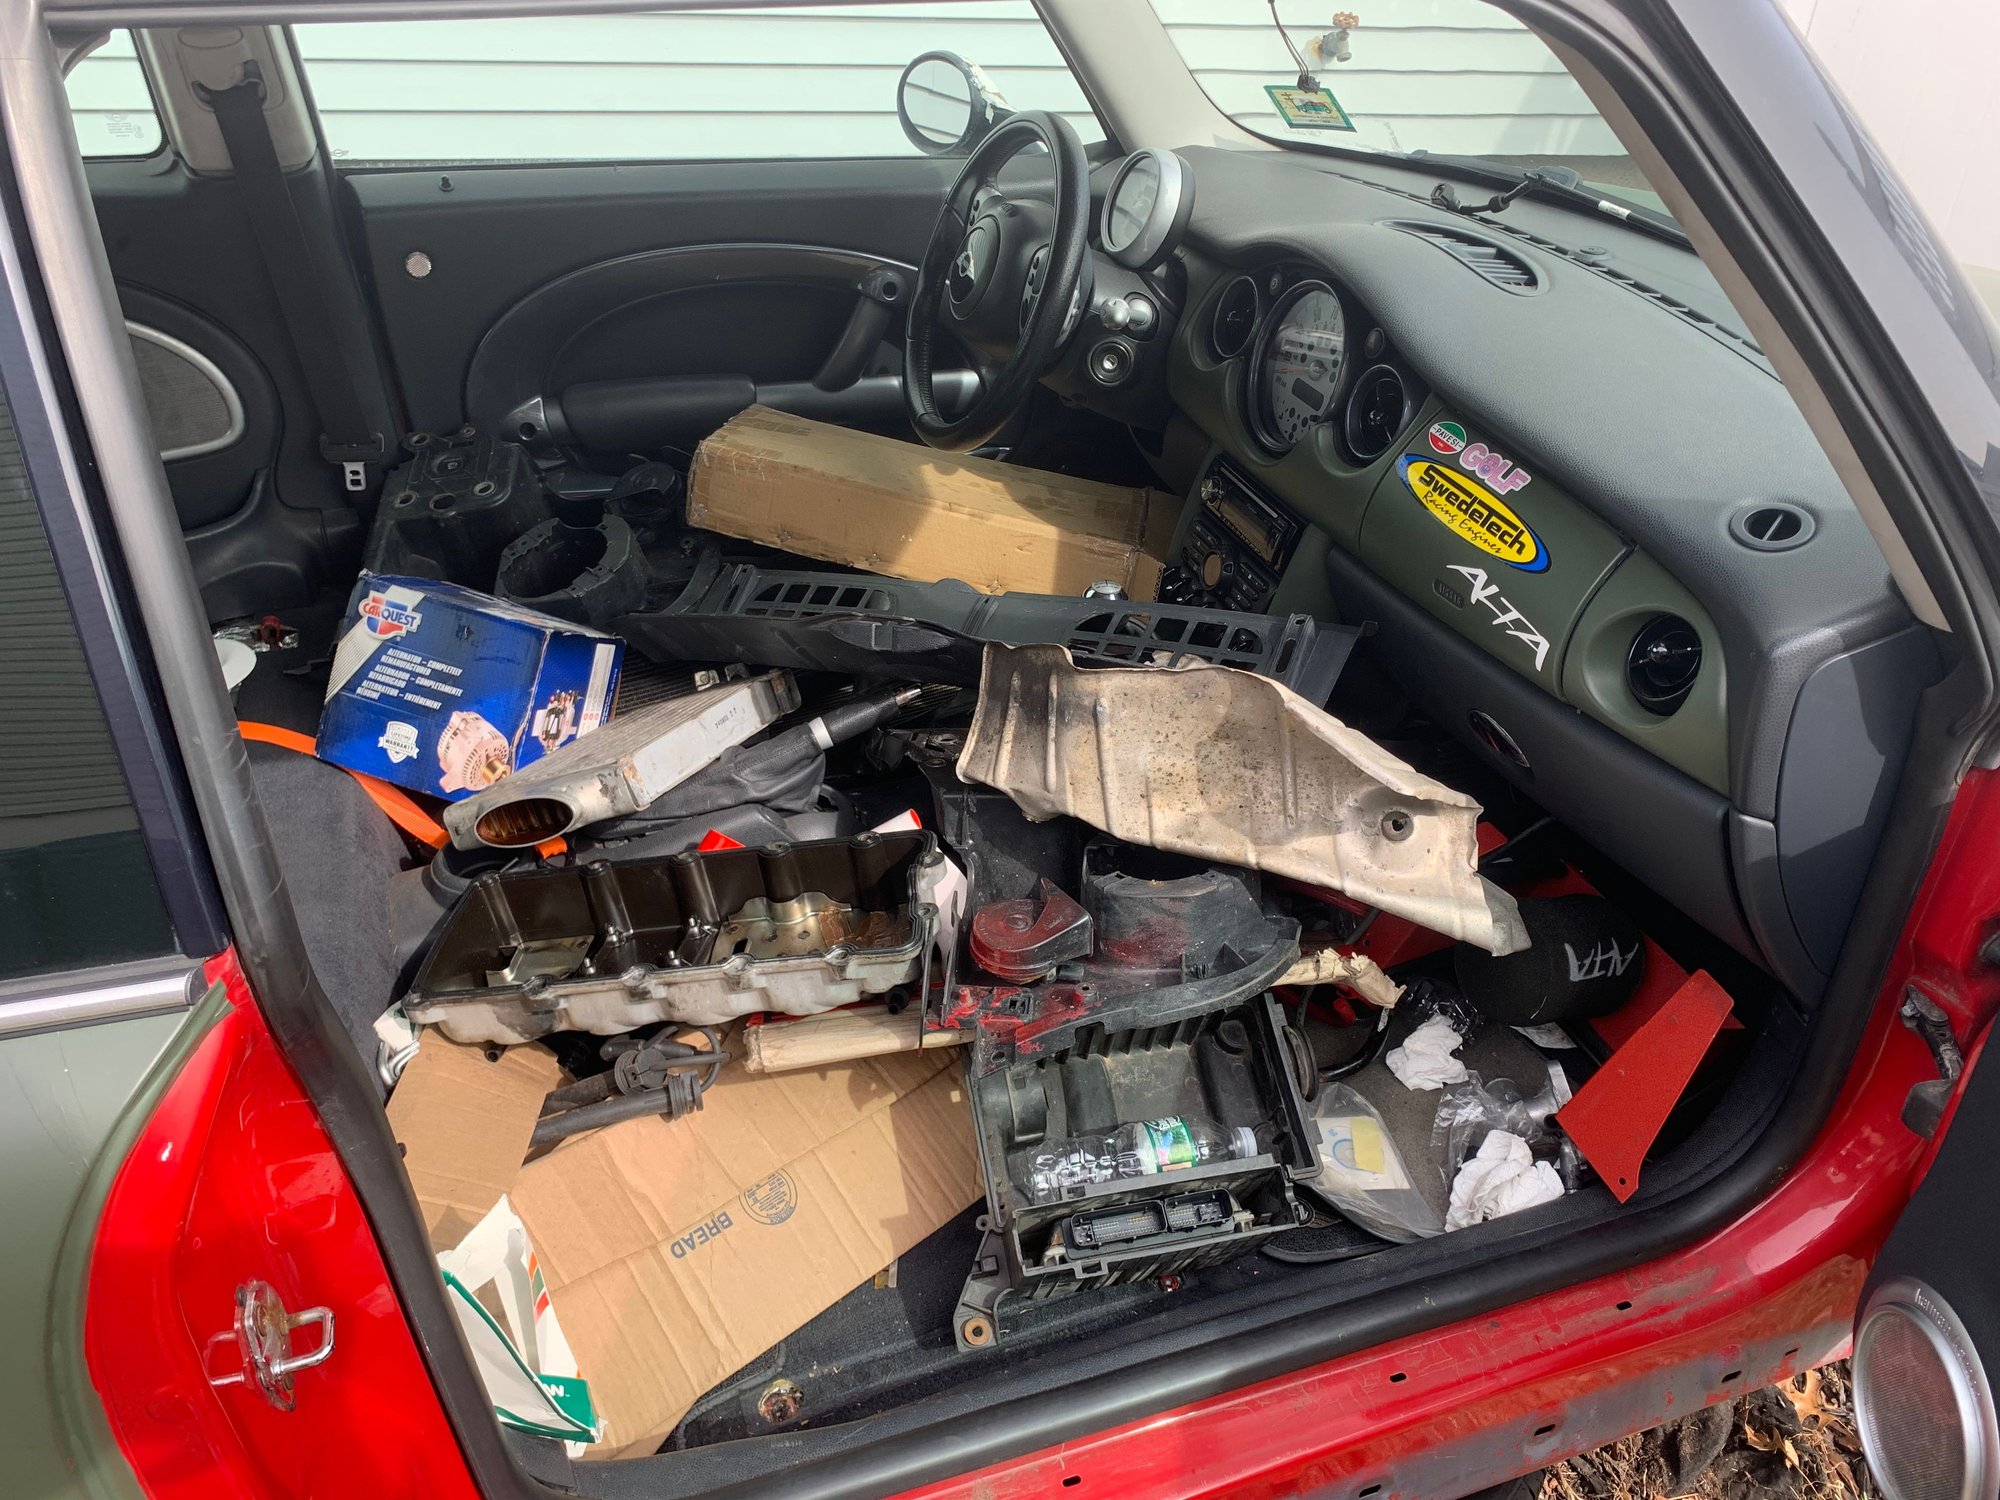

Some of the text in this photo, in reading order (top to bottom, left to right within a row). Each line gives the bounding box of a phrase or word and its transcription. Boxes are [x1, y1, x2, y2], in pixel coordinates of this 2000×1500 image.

[1435, 428, 1460, 448] PAVESI
[1460, 443, 1531, 495] GOLF
[1419, 464, 1526, 556] SwedeTech
[1422, 490, 1502, 554] Racing Engines
[1446, 565, 1550, 672] ALTA
[380, 655, 432, 676] REMANUFACTURED
[387, 648, 422, 665] ALTERNATOR
[427, 660, 463, 677] COMPLETELY
[361, 680, 400, 697] ALTERNATEUR
[415, 676, 463, 697] COMPLETAMENTE
[385, 739, 414, 751] WARRANTY
[671, 1211, 733, 1259] BREAD
